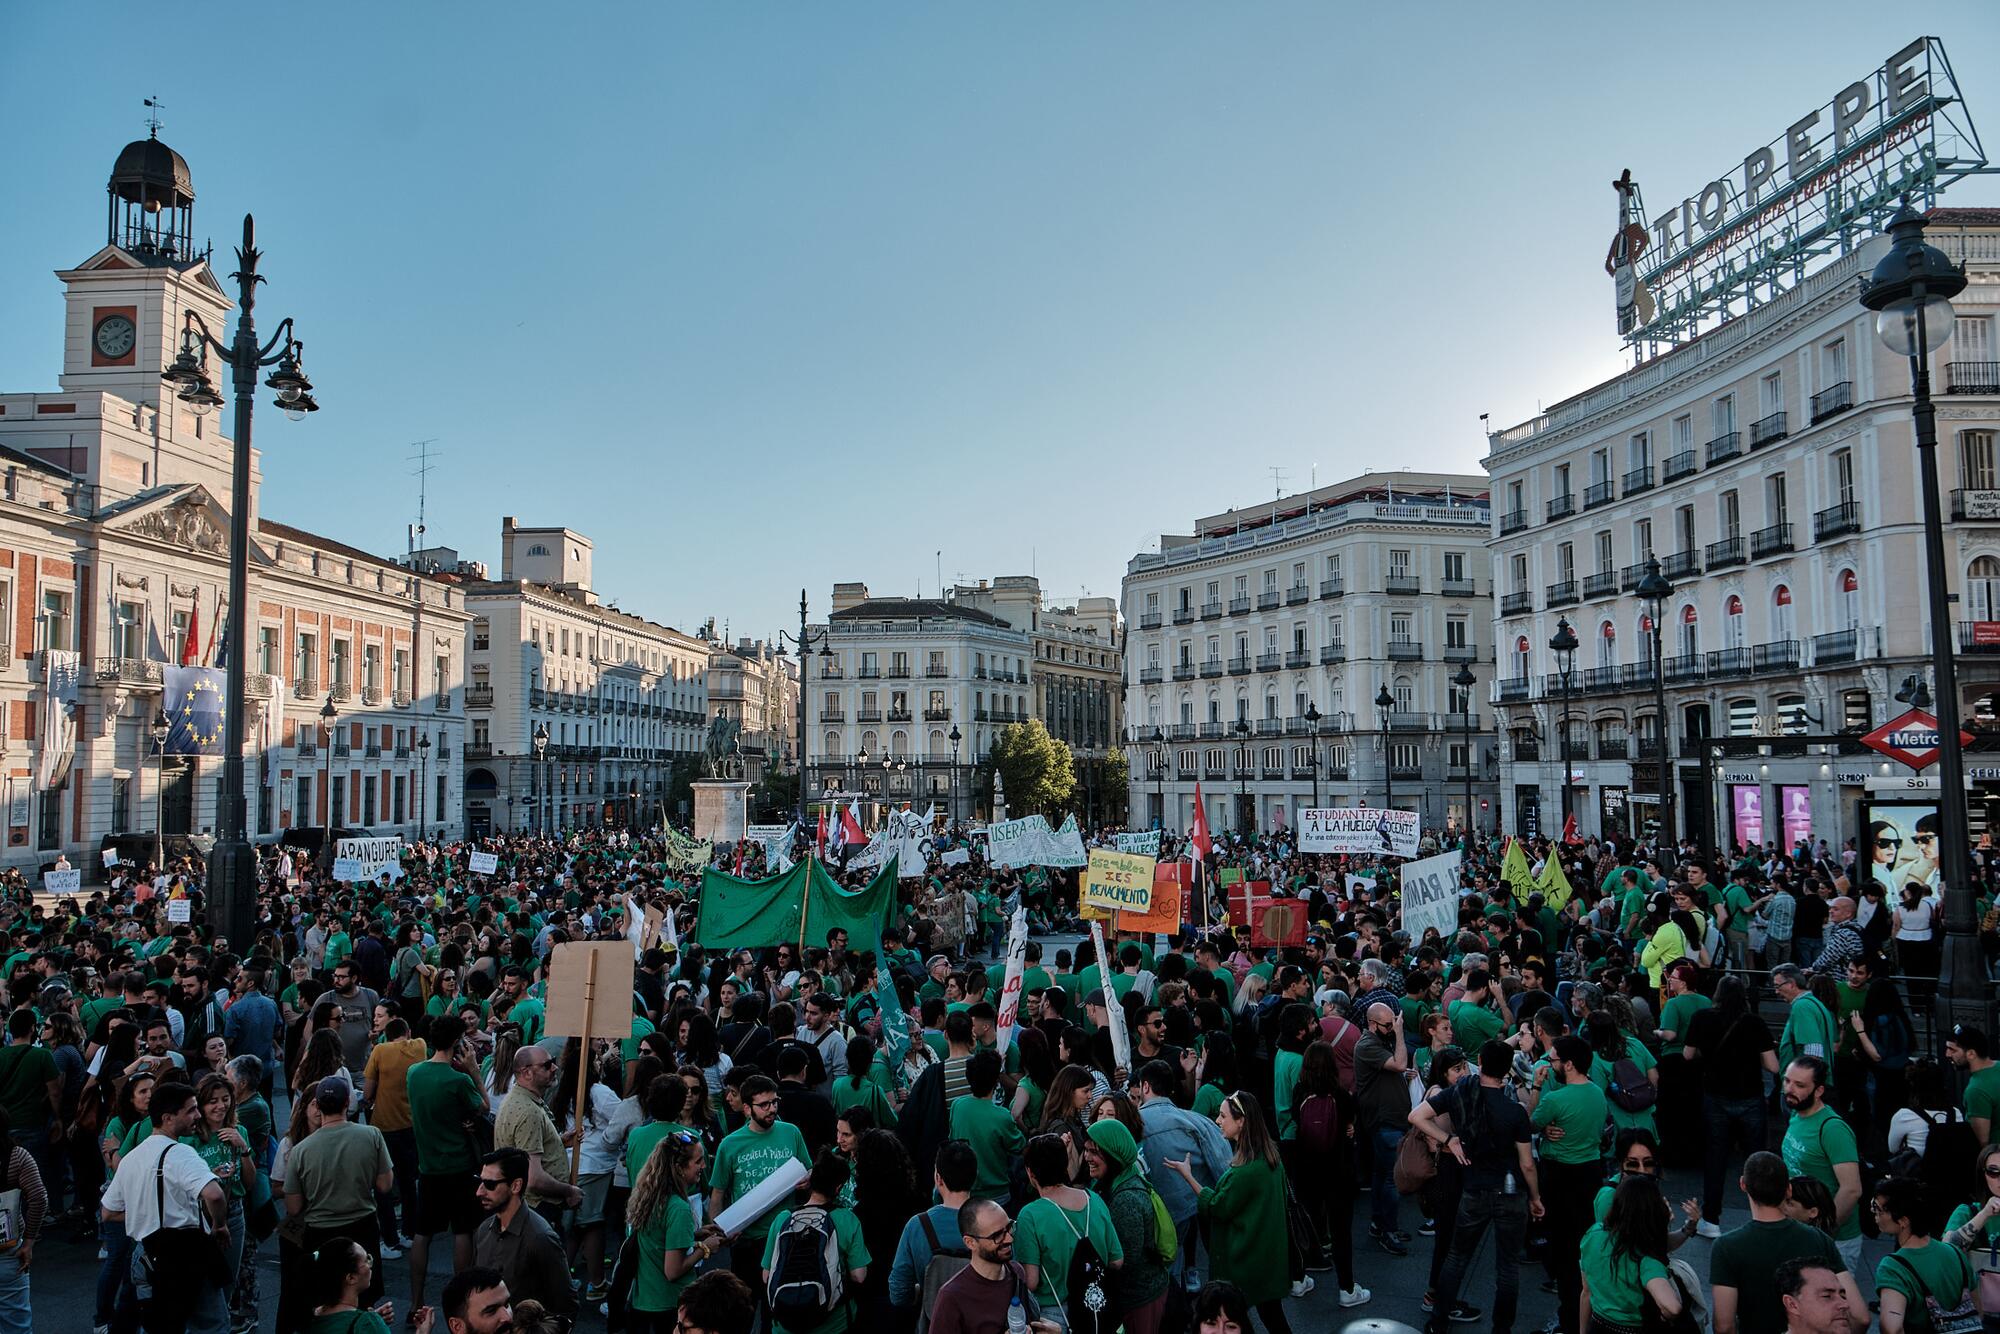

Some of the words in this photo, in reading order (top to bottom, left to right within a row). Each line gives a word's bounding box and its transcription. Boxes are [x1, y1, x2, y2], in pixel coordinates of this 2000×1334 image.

[1654, 181, 1727, 259] TIO
[1744, 36, 1928, 207] PEPE
[1825, 141, 1937, 235] BYASS
[1974, 492, 2000, 501] HOSTAL
[1972, 502, 2000, 511] AMERIC
[1725, 773, 1755, 782] SEPHORA
[1837, 773, 1871, 783] SEPHOR
[1907, 777, 1929, 788] Sol
[1604, 790, 1624, 799] PRIMA
[1604, 799, 1622, 807] VERA
[1305, 809, 1380, 820] ESTUDIANTES
[1383, 810, 1393, 821] EN
[1394, 811, 1417, 824] APOYO
[1605, 807, 1614, 816] TE
[1311, 820, 1319, 832] A
[1325, 820, 1339, 832] LA
[1342, 819, 1378, 832] HUELGA
[1386, 821, 1413, 836] OCENTE
[1119, 836, 1129, 845] IES
[1133, 834, 1151, 844] VILLA
[1305, 833, 1313, 841] Por
[340, 841, 401, 864] ARANGUREN
[362, 866, 372, 876] LA
[1105, 871, 1133, 884] IES
[737, 1148, 768, 1163] ESCUELA
[745, 1168, 758, 1178] DE
